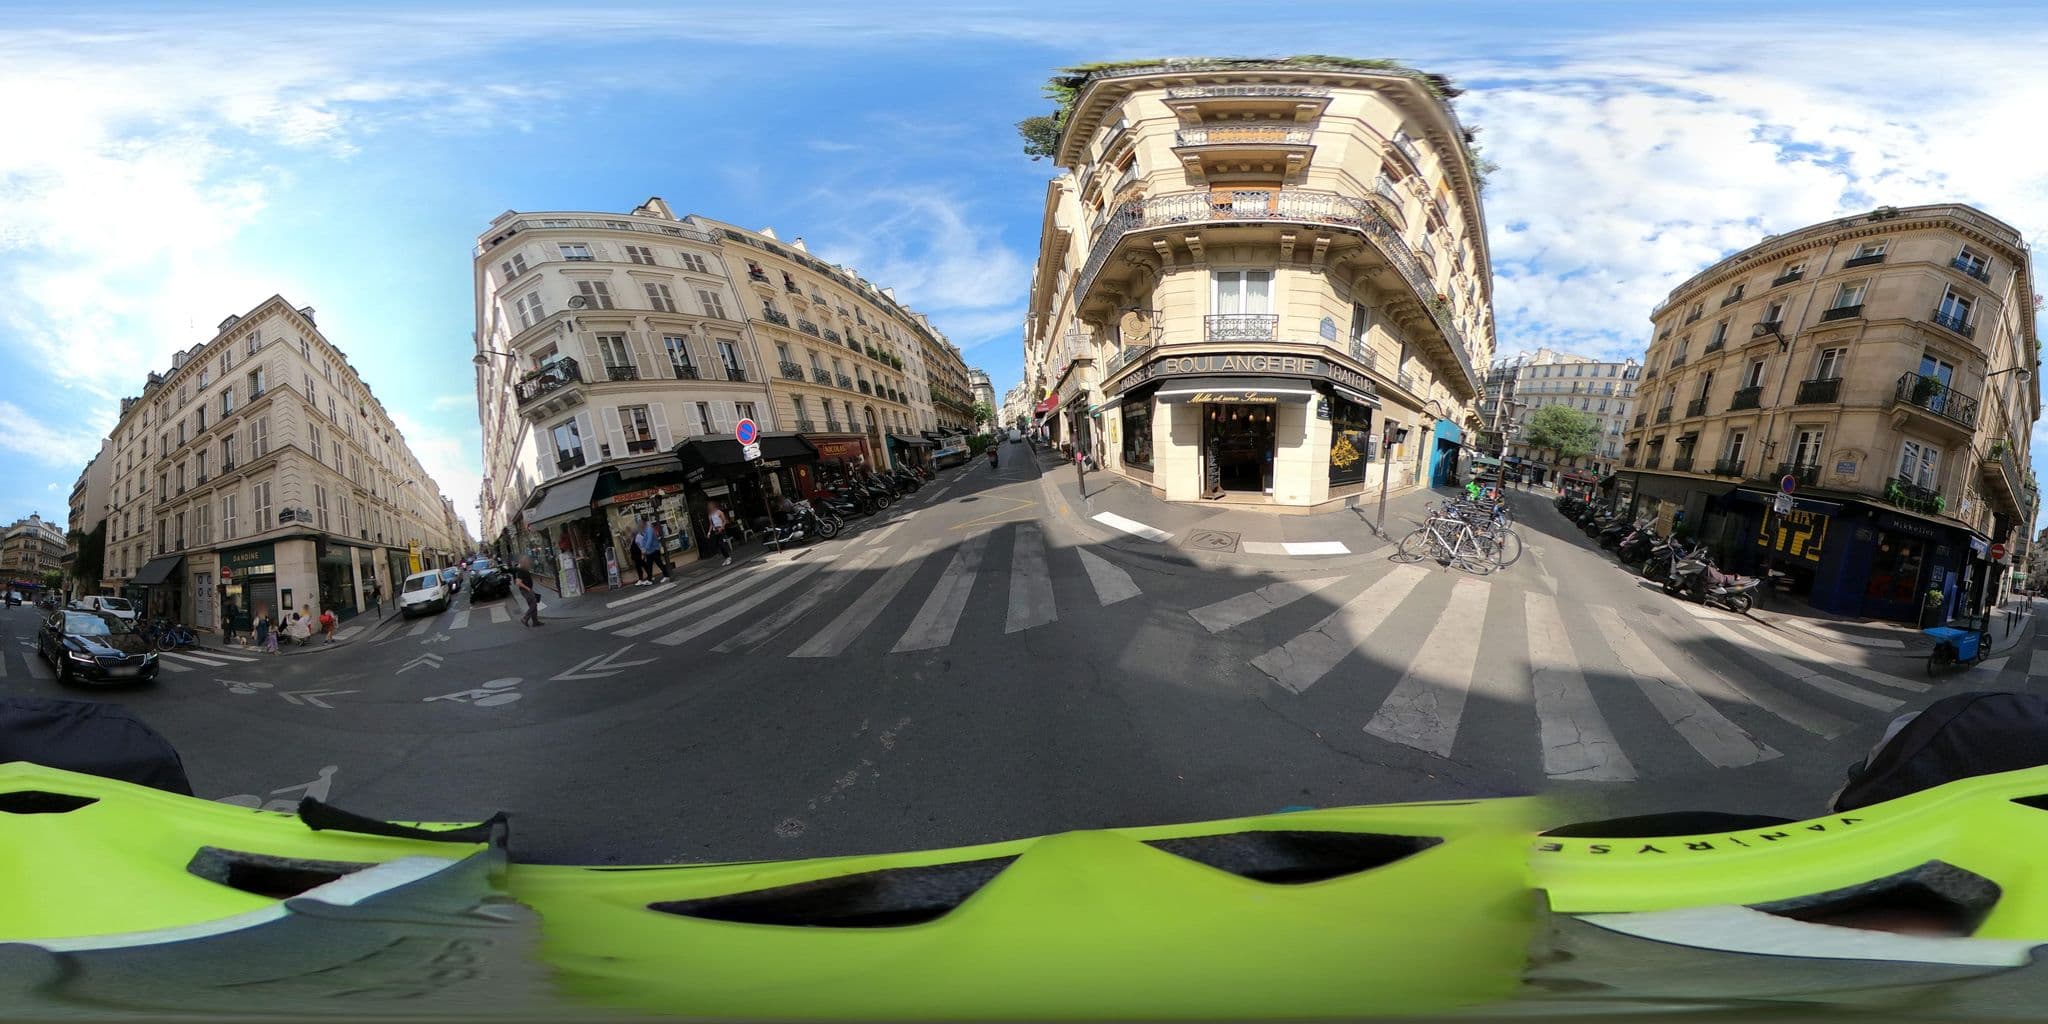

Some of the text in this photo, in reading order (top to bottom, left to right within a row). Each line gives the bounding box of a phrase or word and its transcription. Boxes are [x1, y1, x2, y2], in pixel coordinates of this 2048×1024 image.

[1165, 355, 1317, 374] BOULANGERIE
[1327, 362, 1372, 393] TRAITEUR
[1893, 520, 1935, 536] Mikkeller
